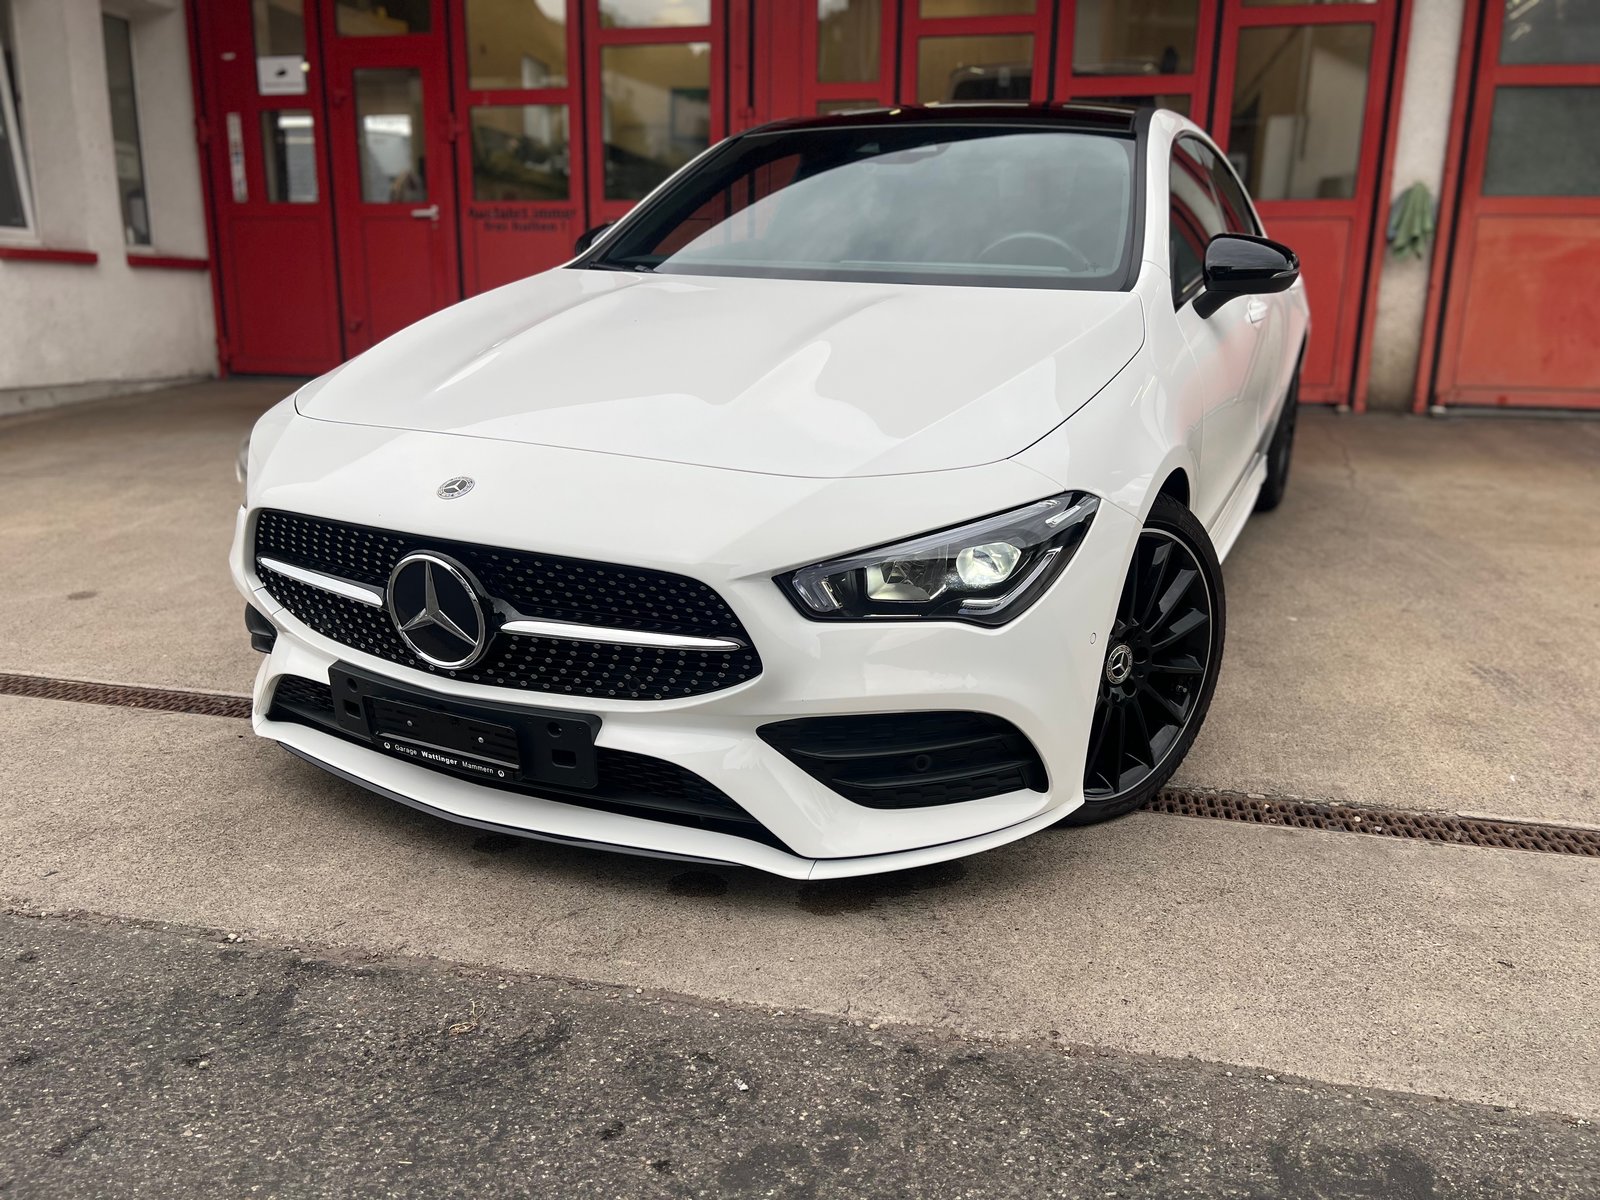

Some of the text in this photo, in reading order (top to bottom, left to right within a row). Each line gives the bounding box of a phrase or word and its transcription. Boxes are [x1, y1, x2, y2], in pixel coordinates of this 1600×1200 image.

[394, 744, 494, 774] Garage Wattinger Mammern
